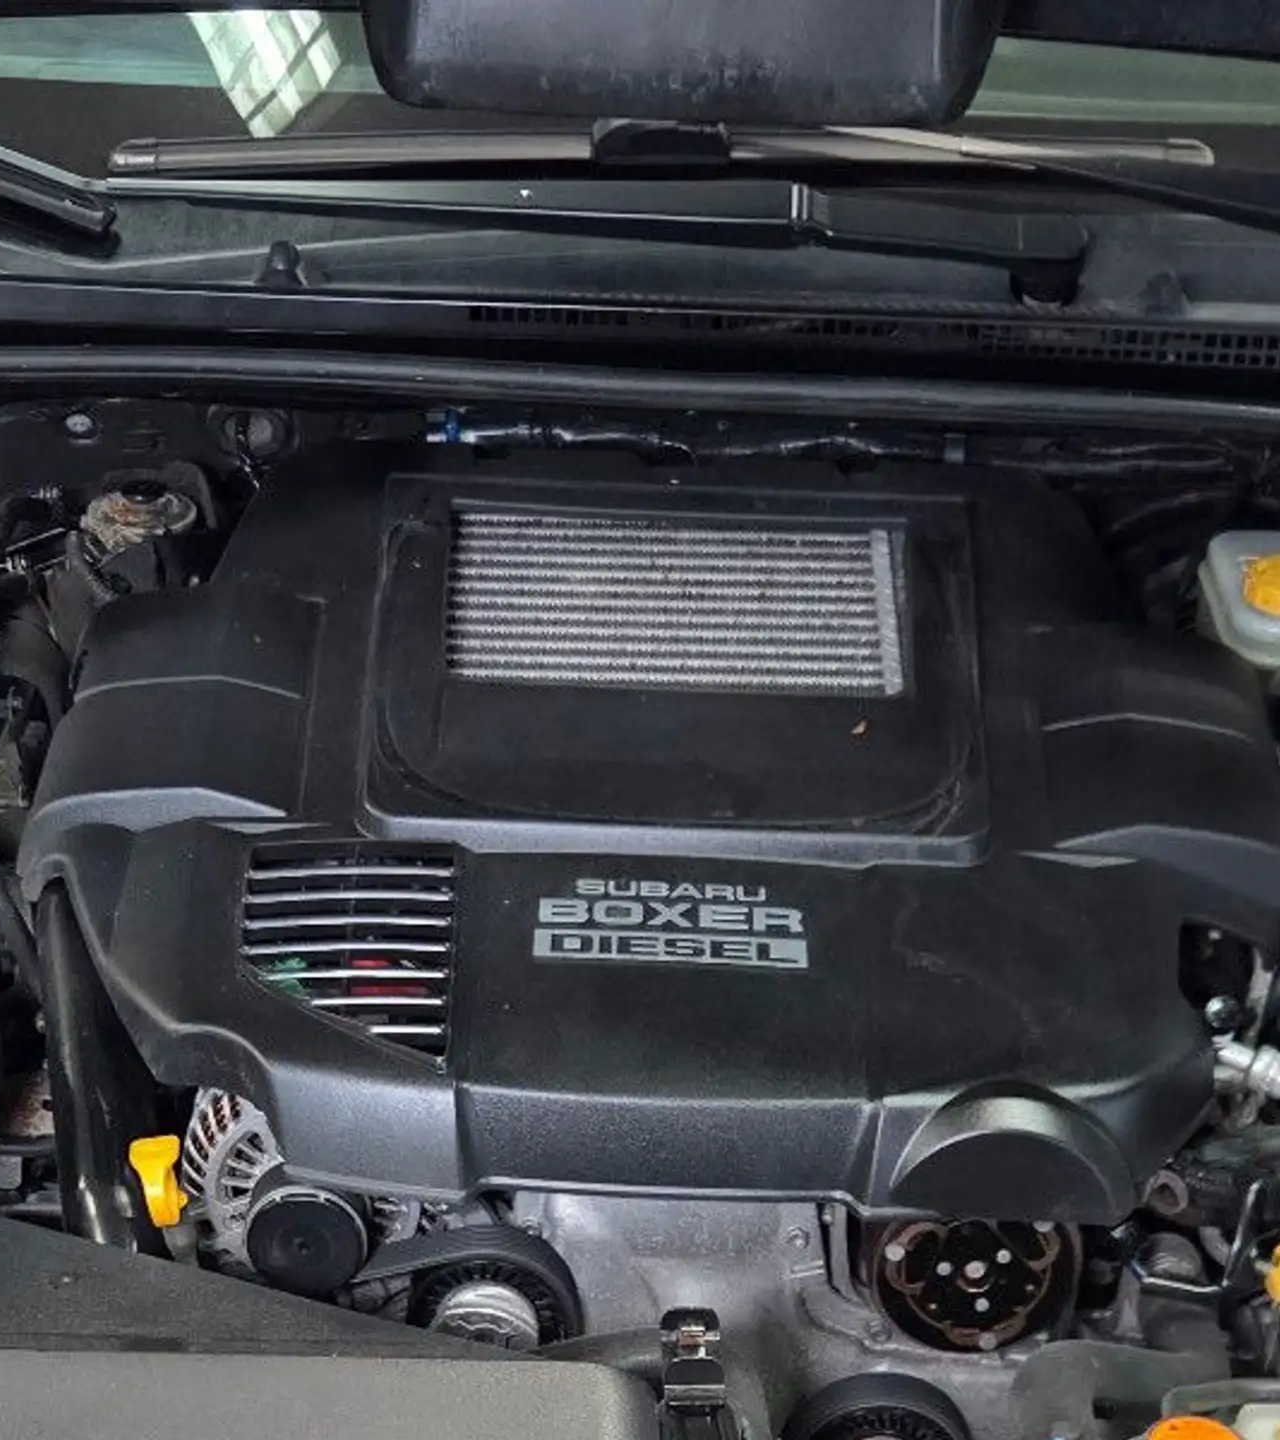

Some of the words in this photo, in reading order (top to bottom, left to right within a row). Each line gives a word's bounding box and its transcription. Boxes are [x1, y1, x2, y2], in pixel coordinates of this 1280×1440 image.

[575, 878, 767, 901] SUBARU
[538, 897, 805, 933] BOXER
[548, 932, 801, 963] DIESEL
